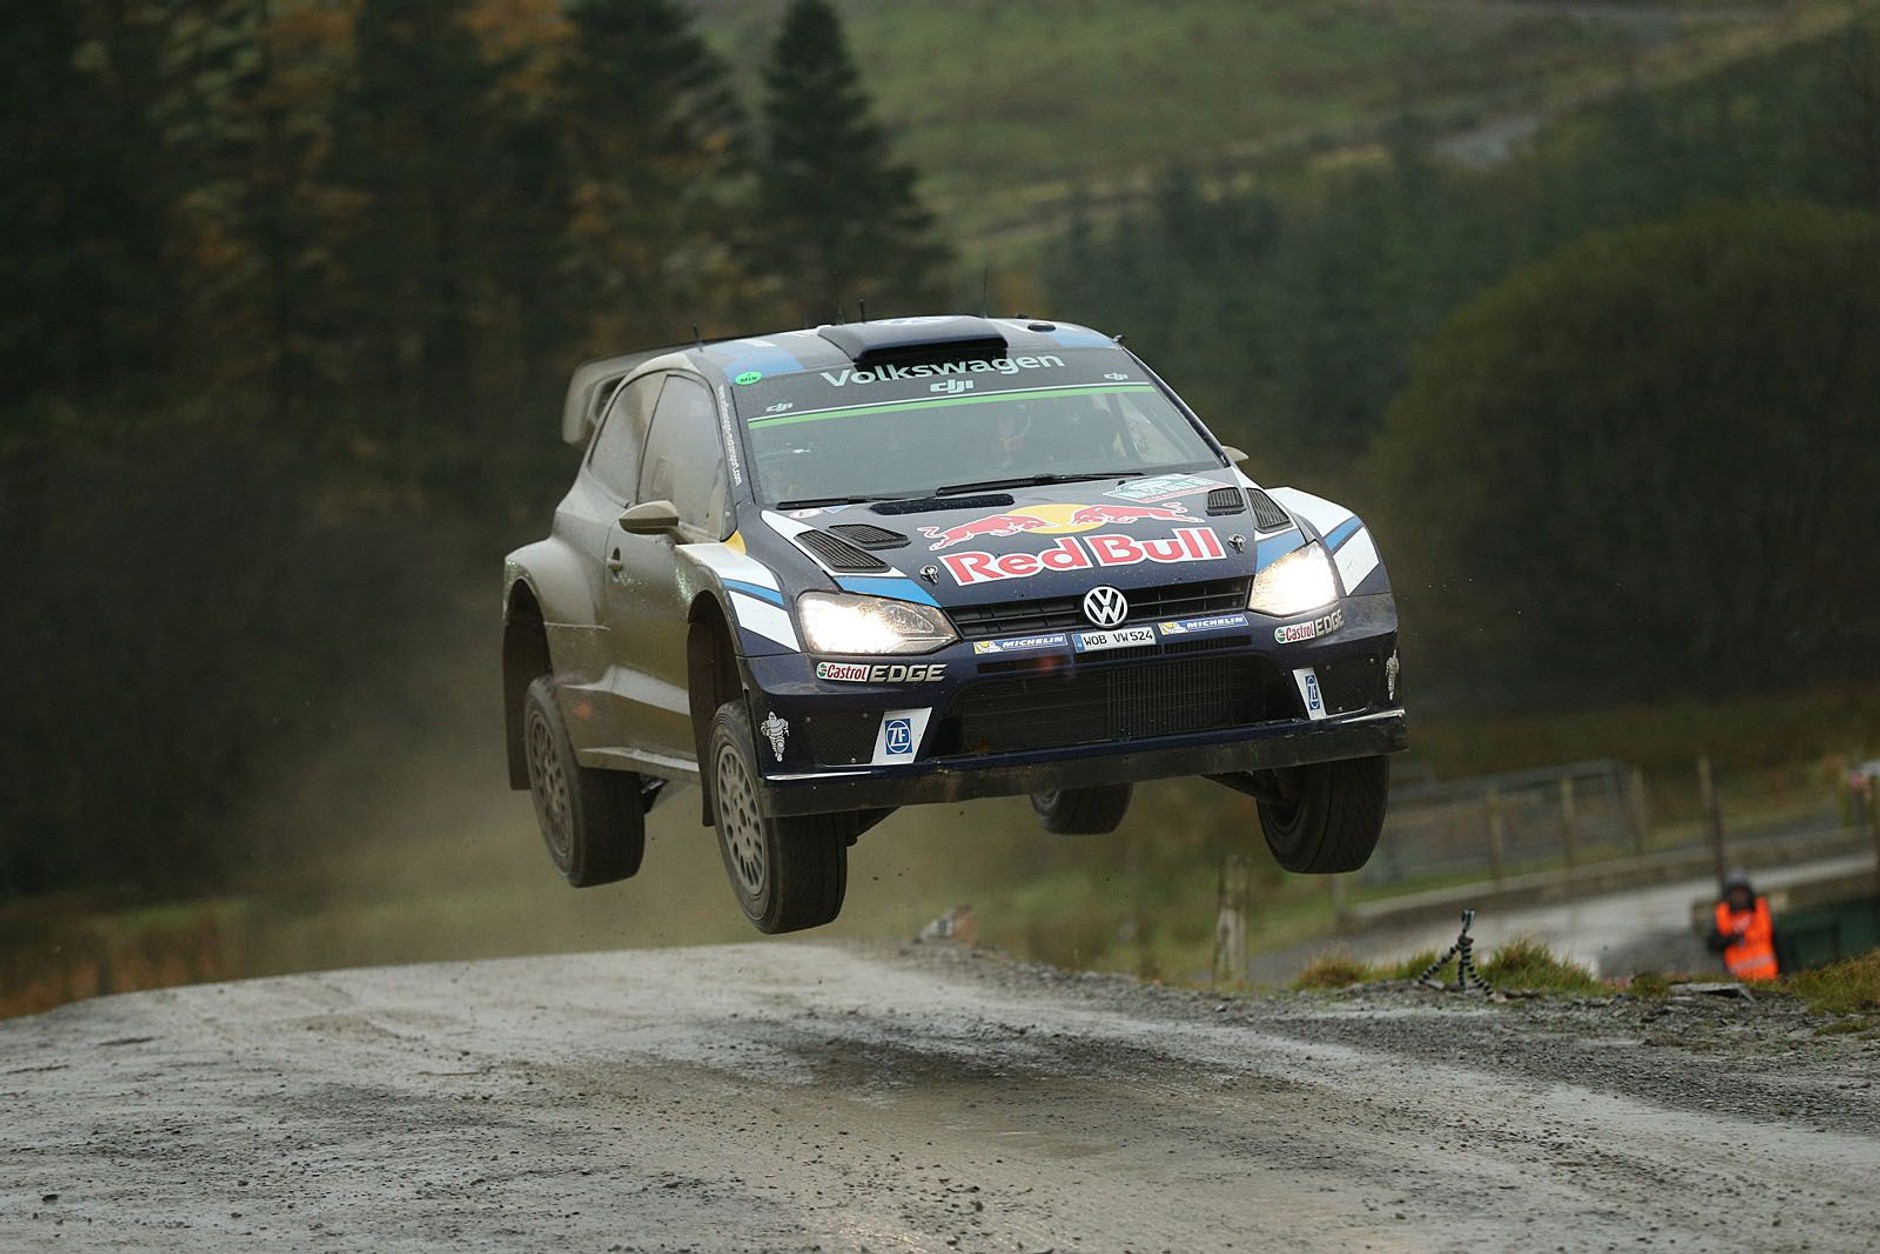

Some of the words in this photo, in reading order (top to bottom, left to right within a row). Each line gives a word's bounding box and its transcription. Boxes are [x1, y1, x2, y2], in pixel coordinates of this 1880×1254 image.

[820, 355, 1065, 388] Volkswagen
[938, 536, 1093, 586] Red
[1083, 527, 1227, 567] Bull
[1187, 616, 1244, 630] MICHELIN
[1285, 623, 1315, 641] Castrol
[1315, 609, 1344, 637] EDGE
[1002, 635, 1064, 649] MICHELIN
[1083, 633, 1107, 646] WOB
[827, 664, 867, 680] Castrol
[868, 664, 948, 682] EDGE
[888, 726, 909, 746] ZF
